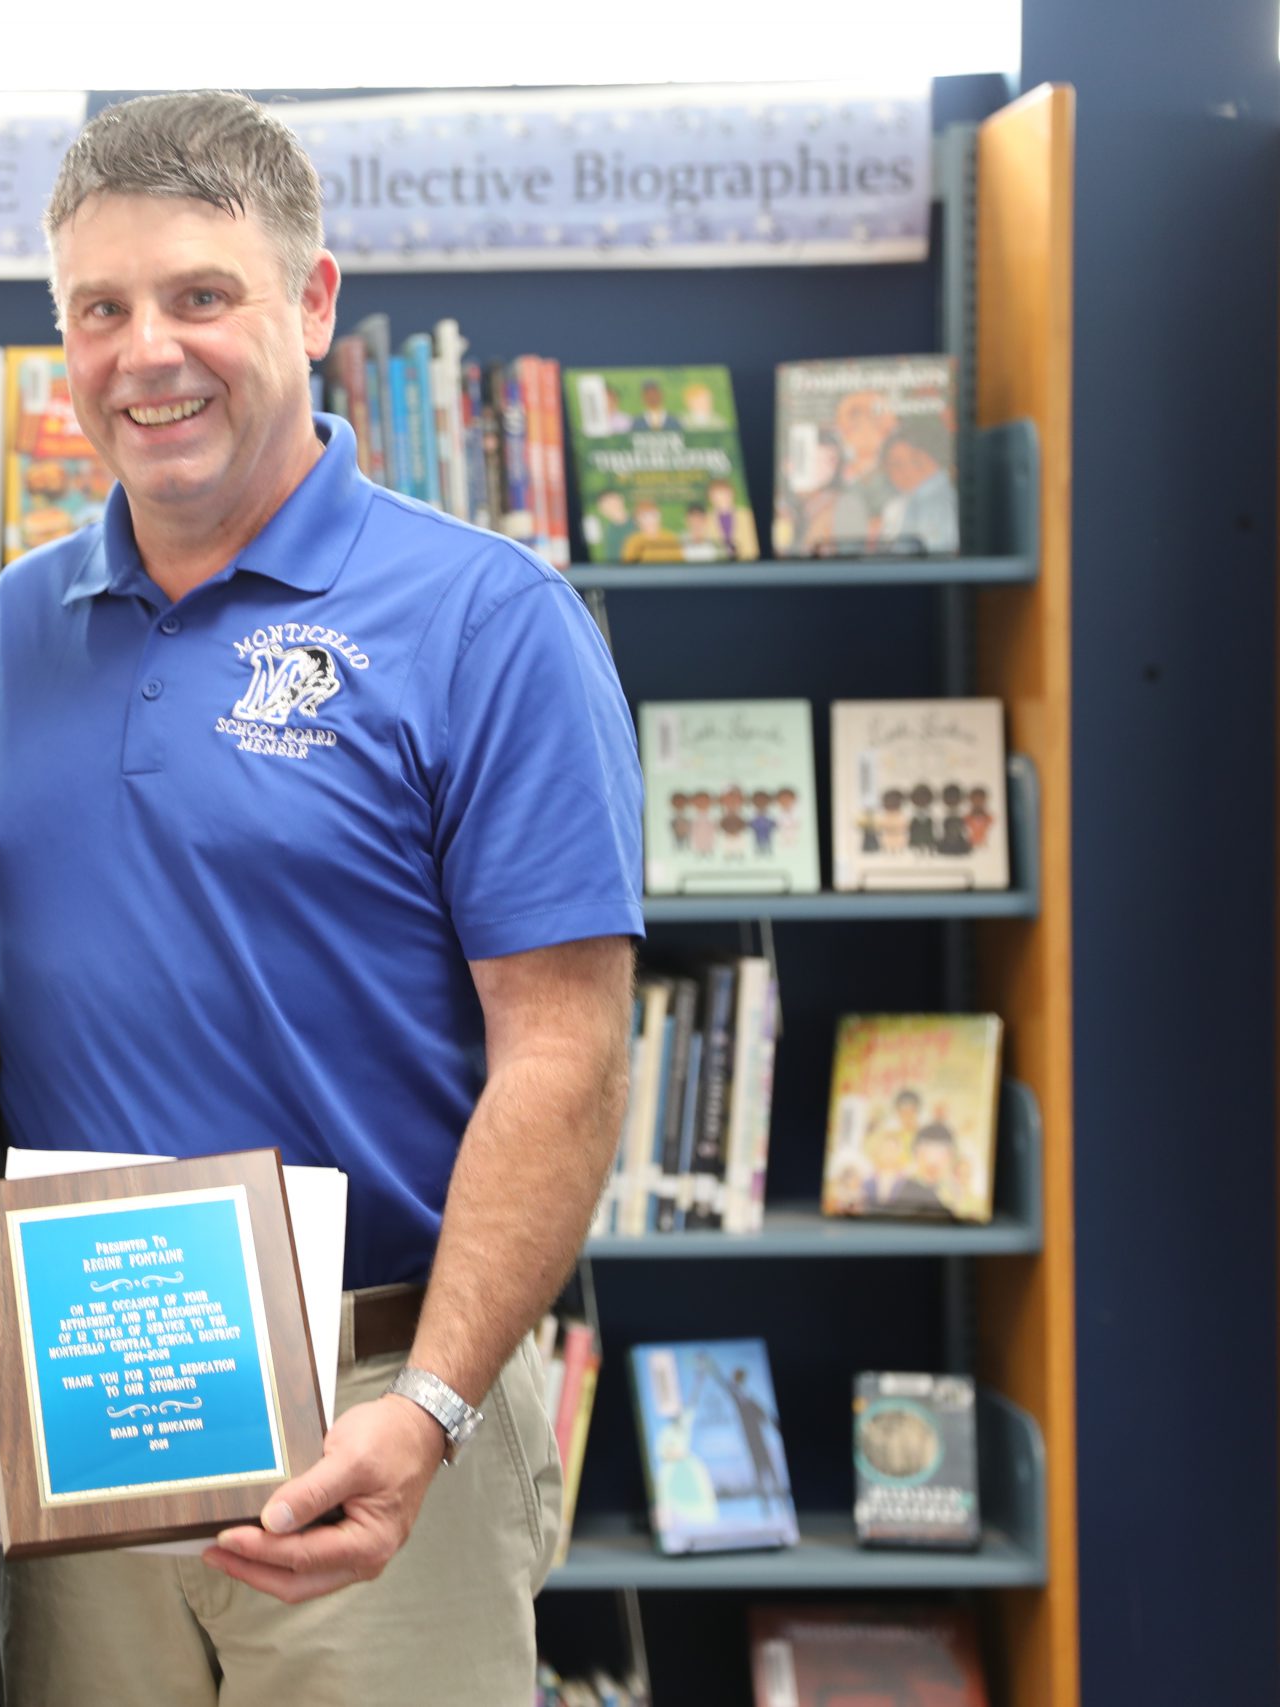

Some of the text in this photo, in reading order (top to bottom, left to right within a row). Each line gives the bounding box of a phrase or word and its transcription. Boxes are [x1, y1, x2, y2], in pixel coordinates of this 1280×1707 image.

[320, 142, 917, 214] ollective Biographies
[232, 622, 370, 670] MONTICELLO
[214, 717, 338, 747] SCHOOL BOARD
[236, 736, 309, 759] MEMBER
[82, 1248, 185, 1273] REGINE FONTAINE
[60, 1301, 222, 1332] RETIREMENT AND IN RECOGNITION
[70, 1290, 209, 1317] ON THE OCCASION OF YOUR
[48, 1325, 240, 1360] MONTICELLO CENTRAL SCHOOL DISTRICT
[58, 1332, 72, 1345] OF
[92, 1326, 123, 1342] YEARS
[128, 1323, 142, 1338] OF
[146, 1318, 186, 1335] SERVICE
[190, 1316, 205, 1330] TO
[208, 1313, 228, 1329] THE
[62, 1358, 237, 1390] THANK YOU FOR YOUR DEDICATION
[105, 1376, 197, 1399] TO OUR STUDENTS
[110, 1418, 204, 1440] BOARD OF EDUCATION
